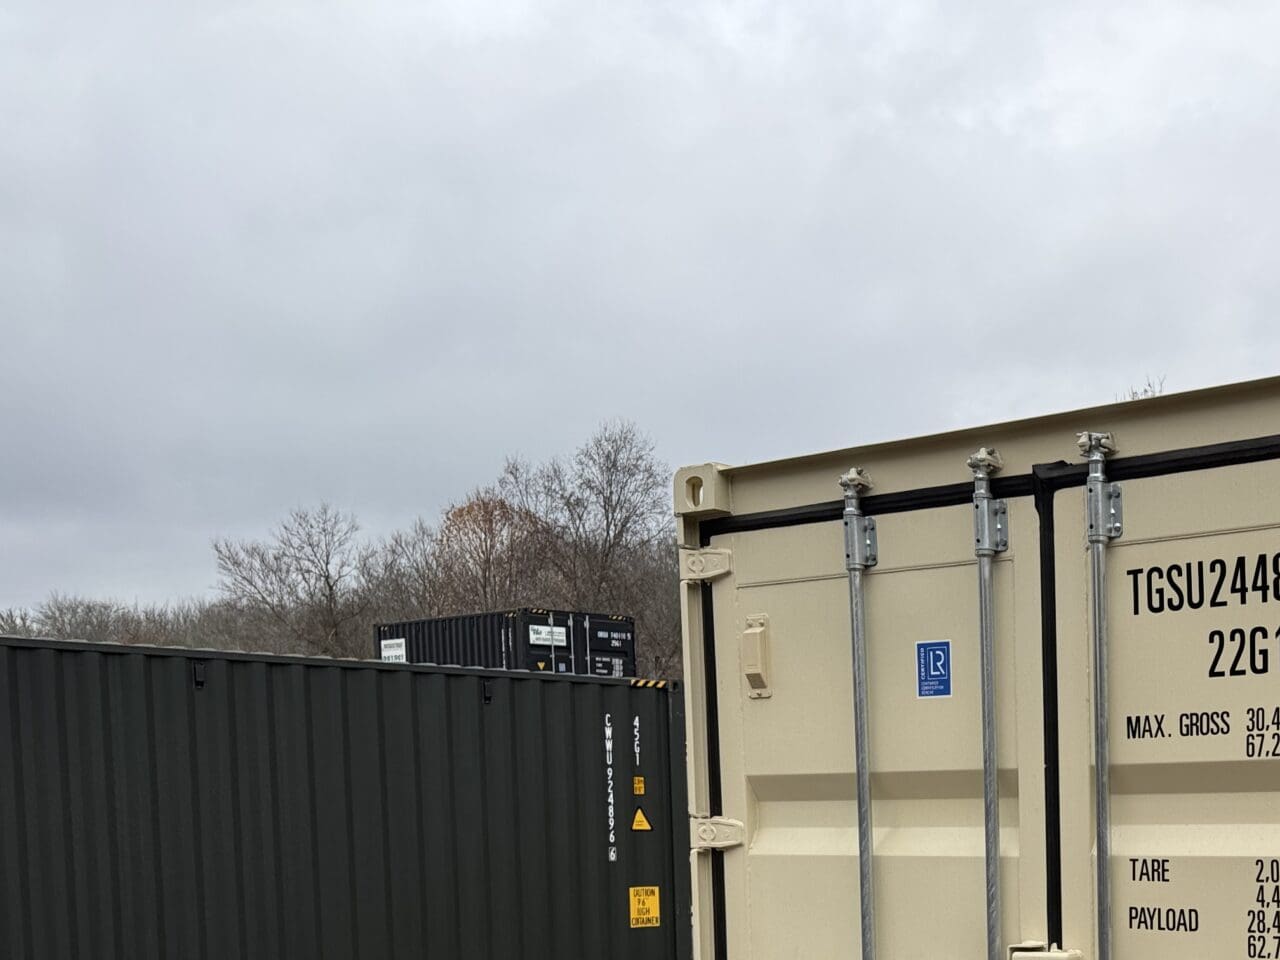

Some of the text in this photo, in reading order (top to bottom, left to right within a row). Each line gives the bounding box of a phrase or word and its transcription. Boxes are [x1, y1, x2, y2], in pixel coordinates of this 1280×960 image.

[930, 650, 945, 675] LR
[1126, 714, 1172, 739] MAX.
[1179, 711, 1230, 737] GROSS
[1129, 858, 1170, 883] TARE
[1129, 906, 1199, 932] PAYLOAD
